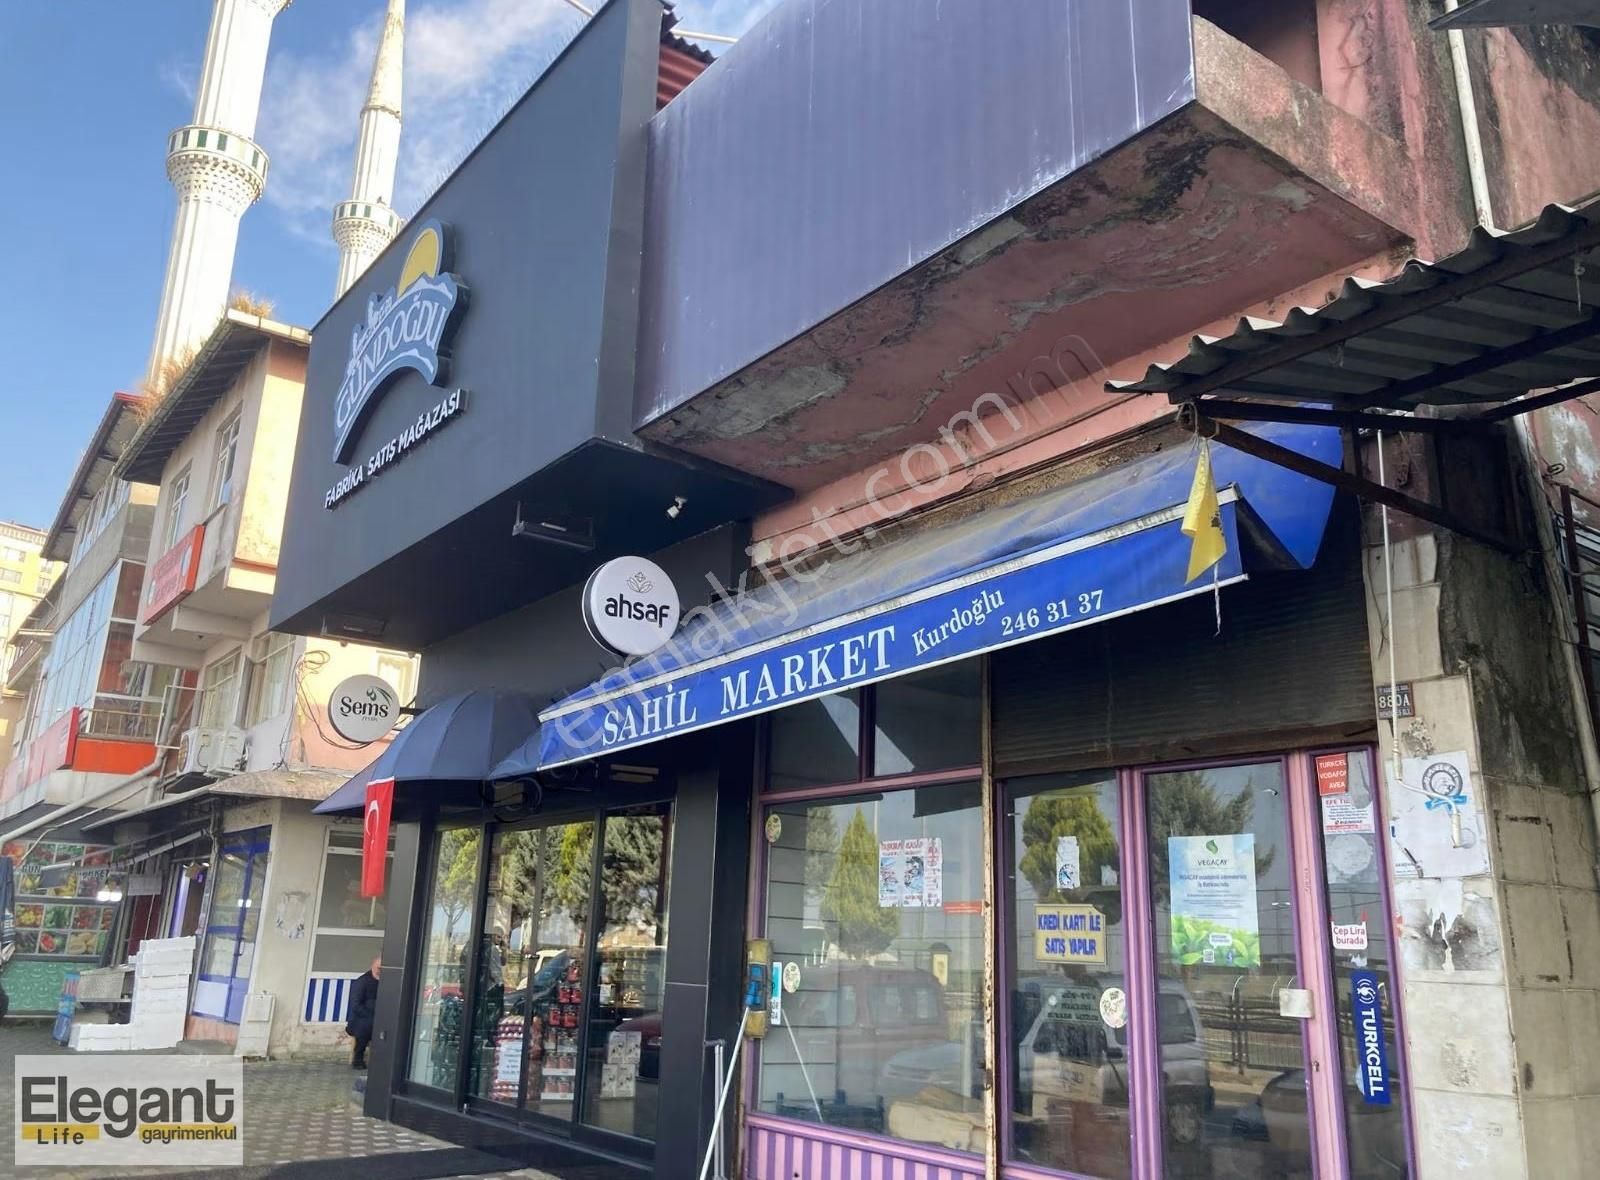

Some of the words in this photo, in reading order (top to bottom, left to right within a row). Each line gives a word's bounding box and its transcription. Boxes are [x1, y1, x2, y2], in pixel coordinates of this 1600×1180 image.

[324, 464, 364, 509] FABRİKA
[367, 438, 397, 476] SATIŞ
[398, 388, 461, 453] MAĞAZASI
[604, 594, 671, 628] ahsaf
[911, 590, 1005, 656] Kurdoğlu
[1001, 609, 1040, 637] 246
[1047, 600, 1072, 623] 31
[1078, 590, 1104, 614] 37
[601, 683, 698, 746] SAHİL
[720, 625, 895, 715] MARKET
[340, 695, 389, 718] Sems
[1038, 911, 1060, 930] KREDİ
[1063, 914, 1087, 931] KARTI
[1089, 911, 1101, 932] İLE
[1333, 926, 1349, 939] Cep
[1350, 926, 1366, 936] Lira
[1045, 938, 1066, 957] SATIŞ
[1069, 938, 1097, 956] YAPILIR
[1335, 935, 1365, 945] burada
[1361, 1007, 1385, 1097] TURKCELL
